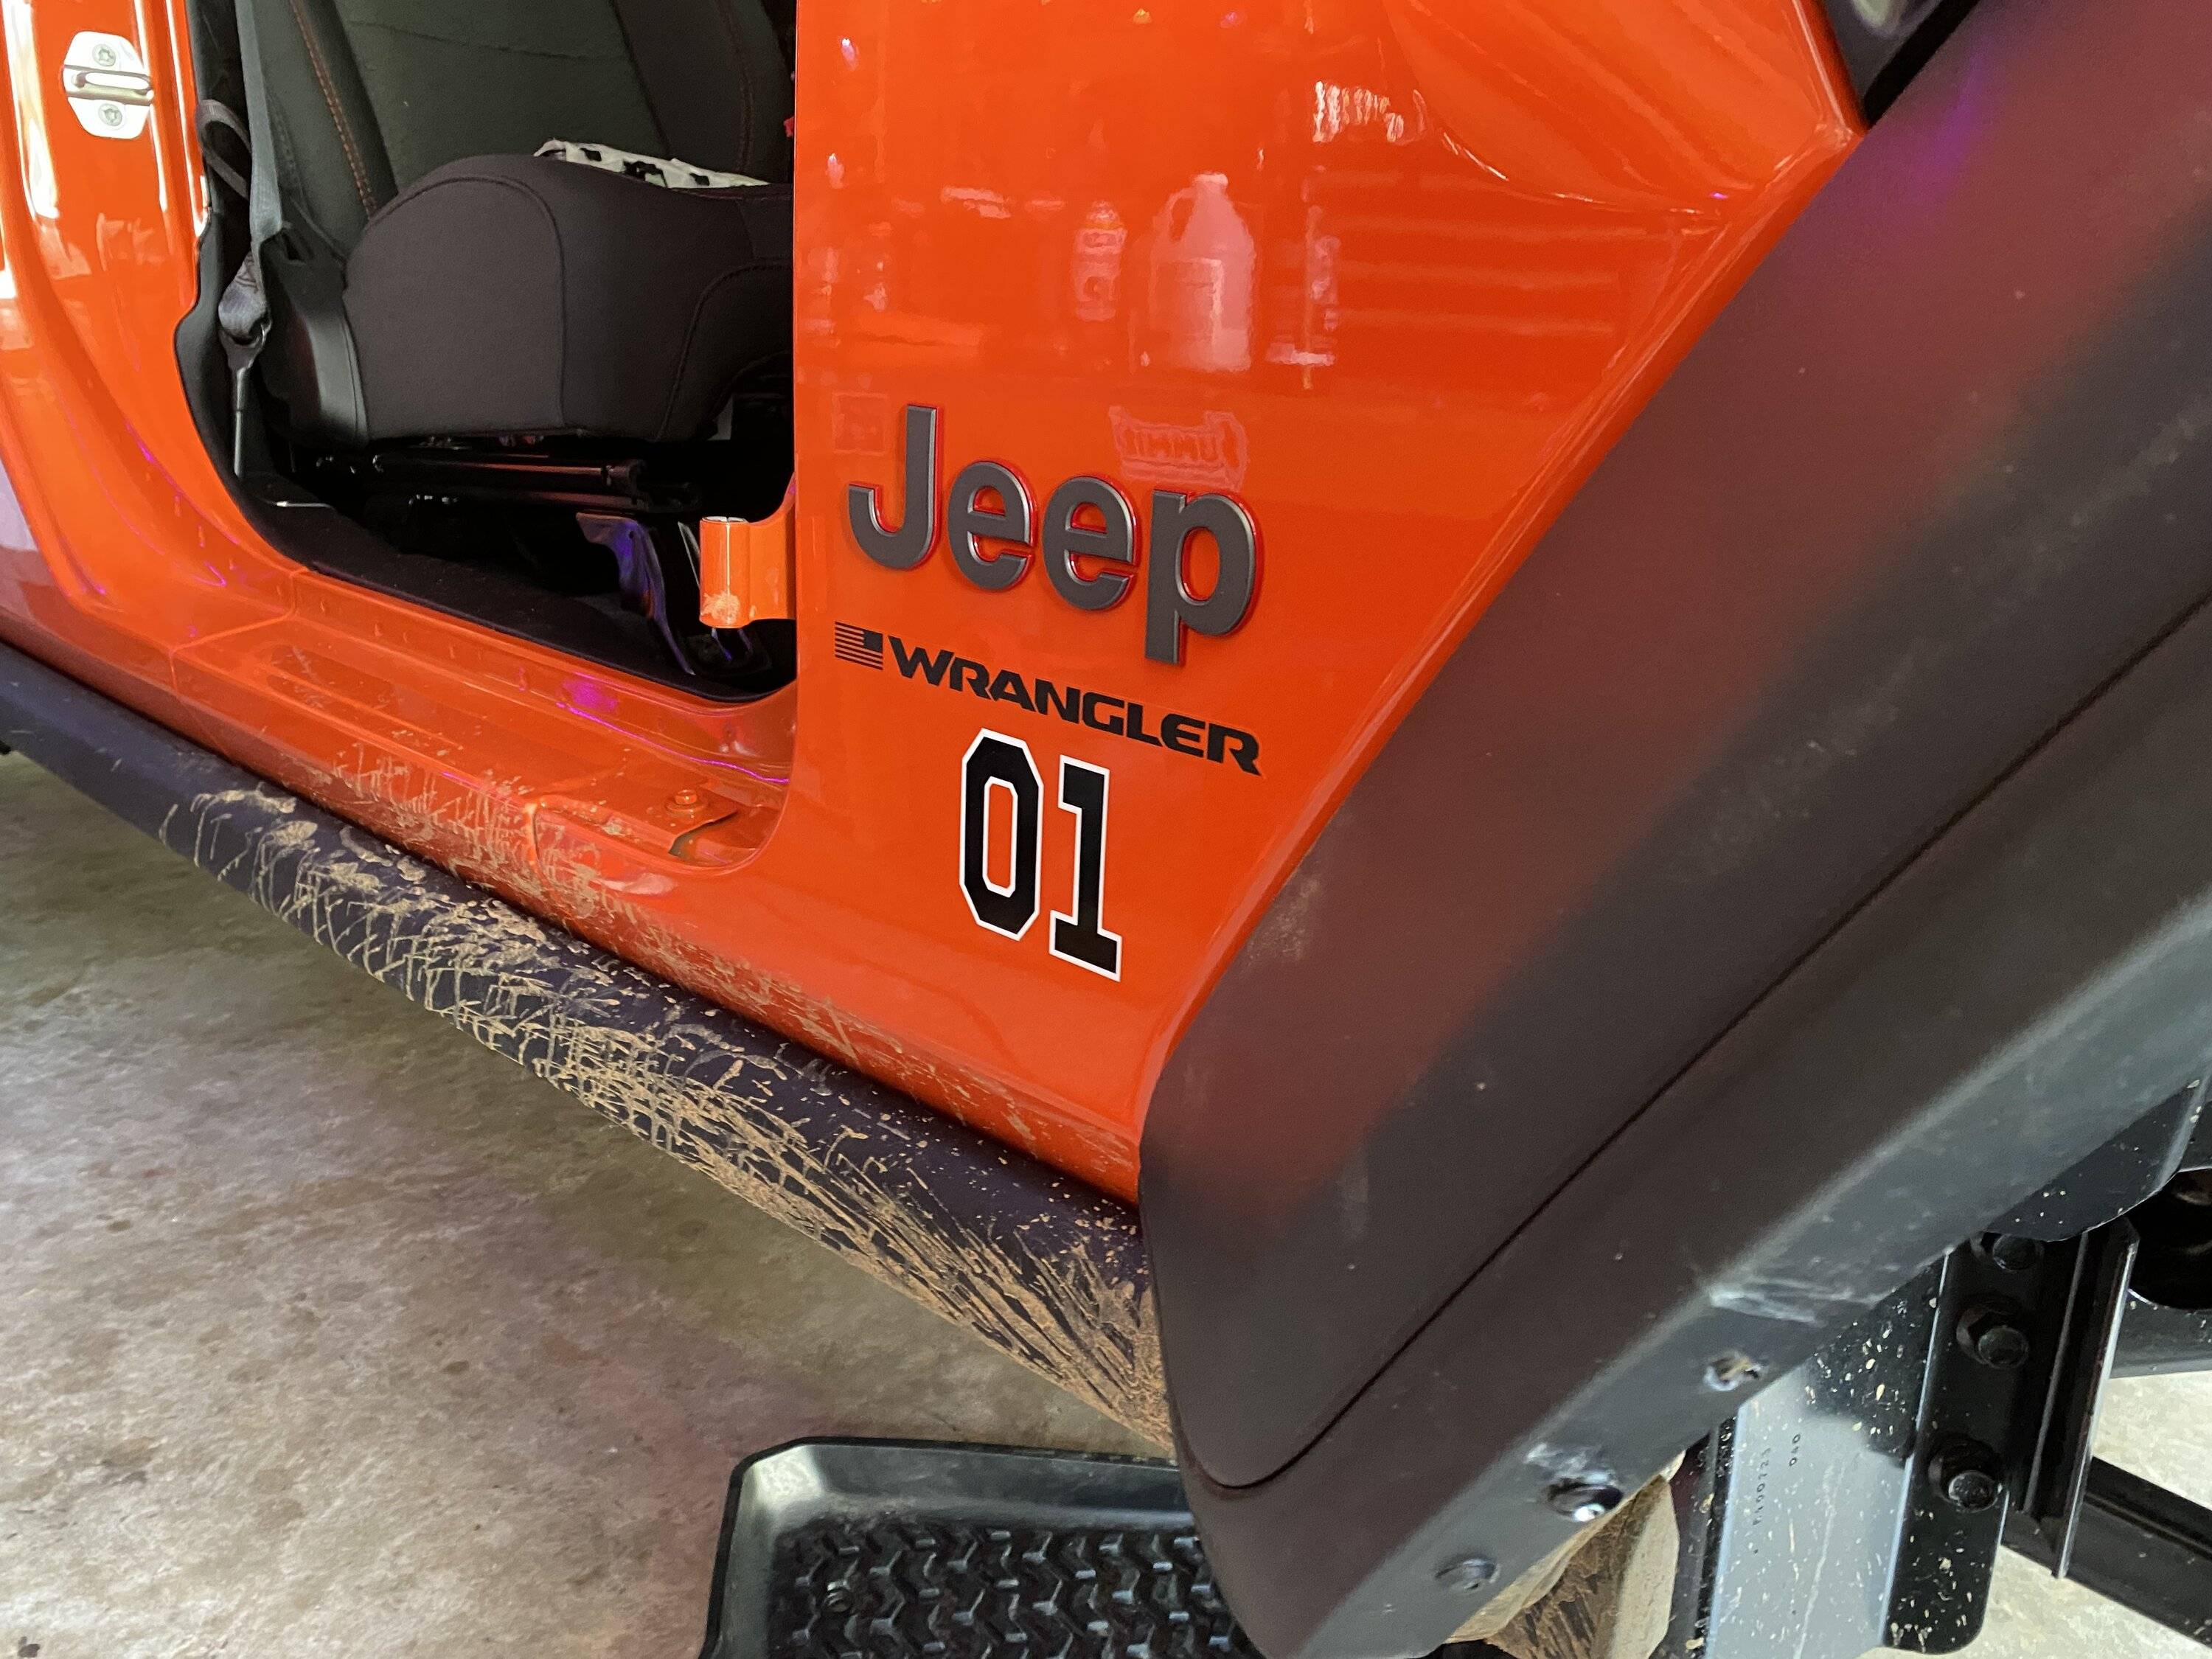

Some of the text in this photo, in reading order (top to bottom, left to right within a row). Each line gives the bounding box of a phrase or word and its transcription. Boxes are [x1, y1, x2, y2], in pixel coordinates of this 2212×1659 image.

[849, 404, 1262, 665] Jeep
[887, 636, 1262, 775] WRANGLER
[960, 728, 1121, 981] 01
